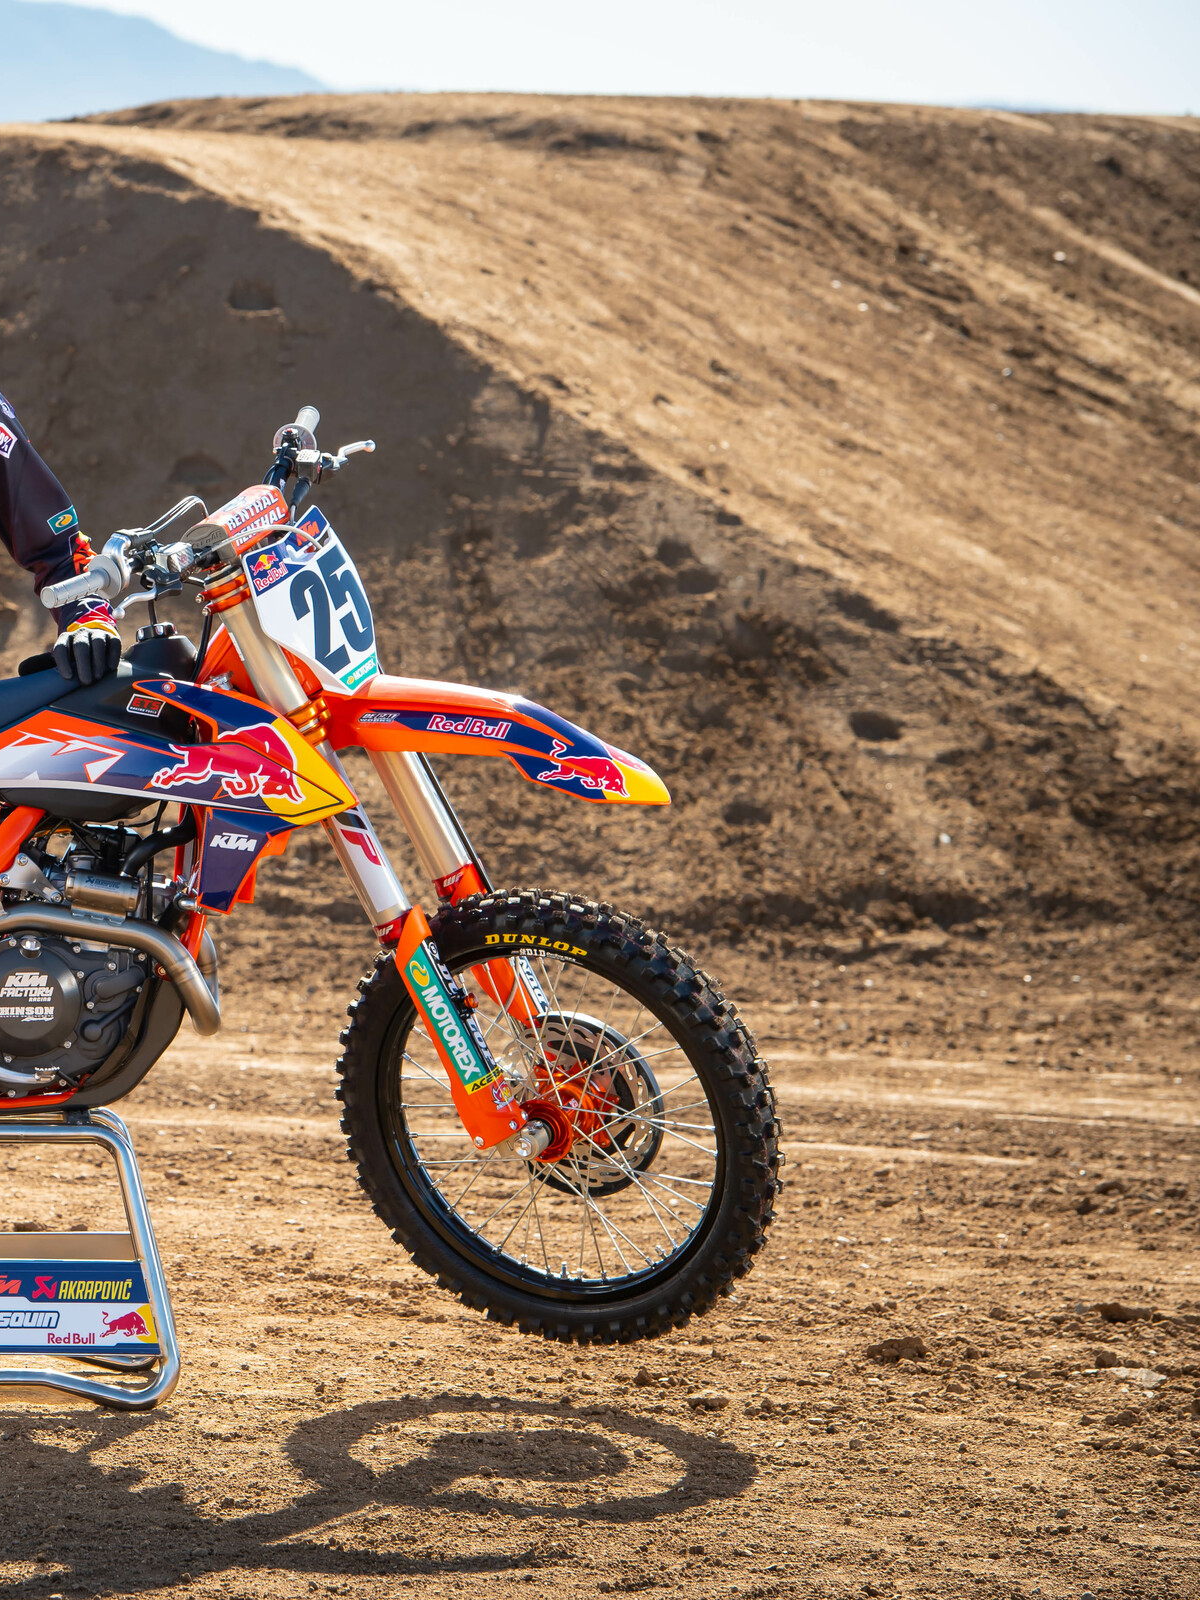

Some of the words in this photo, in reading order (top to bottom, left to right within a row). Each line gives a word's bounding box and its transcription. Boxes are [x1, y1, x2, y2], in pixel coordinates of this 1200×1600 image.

[226, 491, 279, 531] RENTHAL
[254, 573, 275, 591] Red
[272, 562, 288, 582] Bull
[290, 544, 374, 674] 25
[352, 658, 377, 680] MOTOREX
[132, 697, 161, 710] ETS
[427, 715, 471, 734] Red
[468, 719, 512, 739] Bull
[210, 832, 257, 851] KTM
[485, 934, 588, 956] DUNLOP
[5, 972, 48, 987] KTM
[0, 987, 54, 998] FACTORY
[0, 1006, 54, 1015] HINSON
[438, 963, 498, 1067] DULOP
[421, 985, 482, 1080] MOTOREX
[47, 1333, 71, 1344] Red
[73, 1333, 95, 1344] Bull
